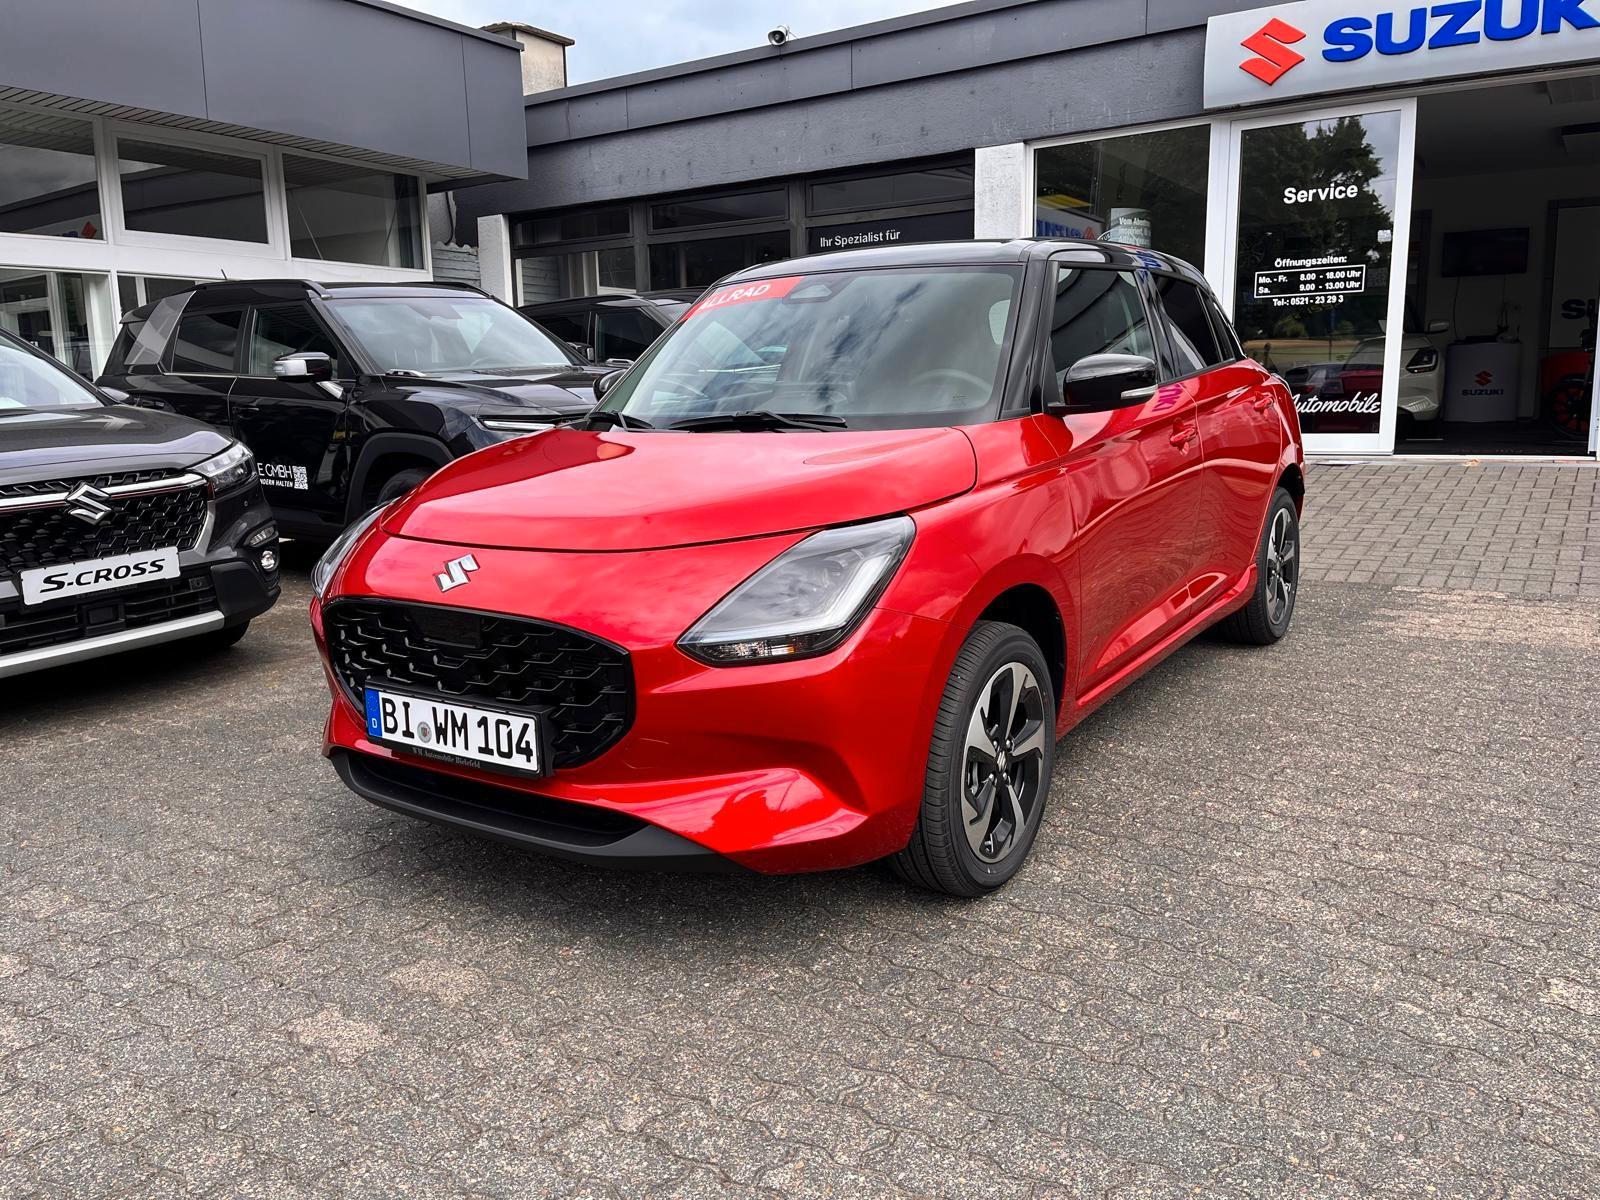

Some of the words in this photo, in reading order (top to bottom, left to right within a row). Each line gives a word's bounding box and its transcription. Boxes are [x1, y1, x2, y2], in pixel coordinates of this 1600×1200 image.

[1283, 184, 1358, 204] Service
[820, 237, 833, 248] Ihr
[834, 232, 883, 248] Spezialist
[885, 229, 901, 241] für
[1274, 256, 1348, 268] Öffnungszeiten:
[1258, 276, 1272, 284] Mo.
[1278, 275, 1288, 283] Fr.
[1299, 273, 1316, 281] 8.00
[1325, 271, 1345, 279] 18.00
[1346, 270, 1362, 279] Uhr
[1258, 286, 1271, 294] Sa.
[1299, 283, 1315, 292] 9.00
[1325, 281, 1345, 290] 13.00
[1345, 281, 1361, 289] Uhr
[1290, 296, 1308, 306] 0521
[1315, 296, 1325, 304] 23
[1326, 295, 1337, 303] 29
[1338, 294, 1344, 303] 3
[275, 480, 294, 488] HALTEN
[40, 558, 166, 594] S-CROSS
[371, 717, 378, 728] D
[382, 697, 415, 739] BI
[431, 706, 469, 751] WM
[476, 715, 534, 763] 104
